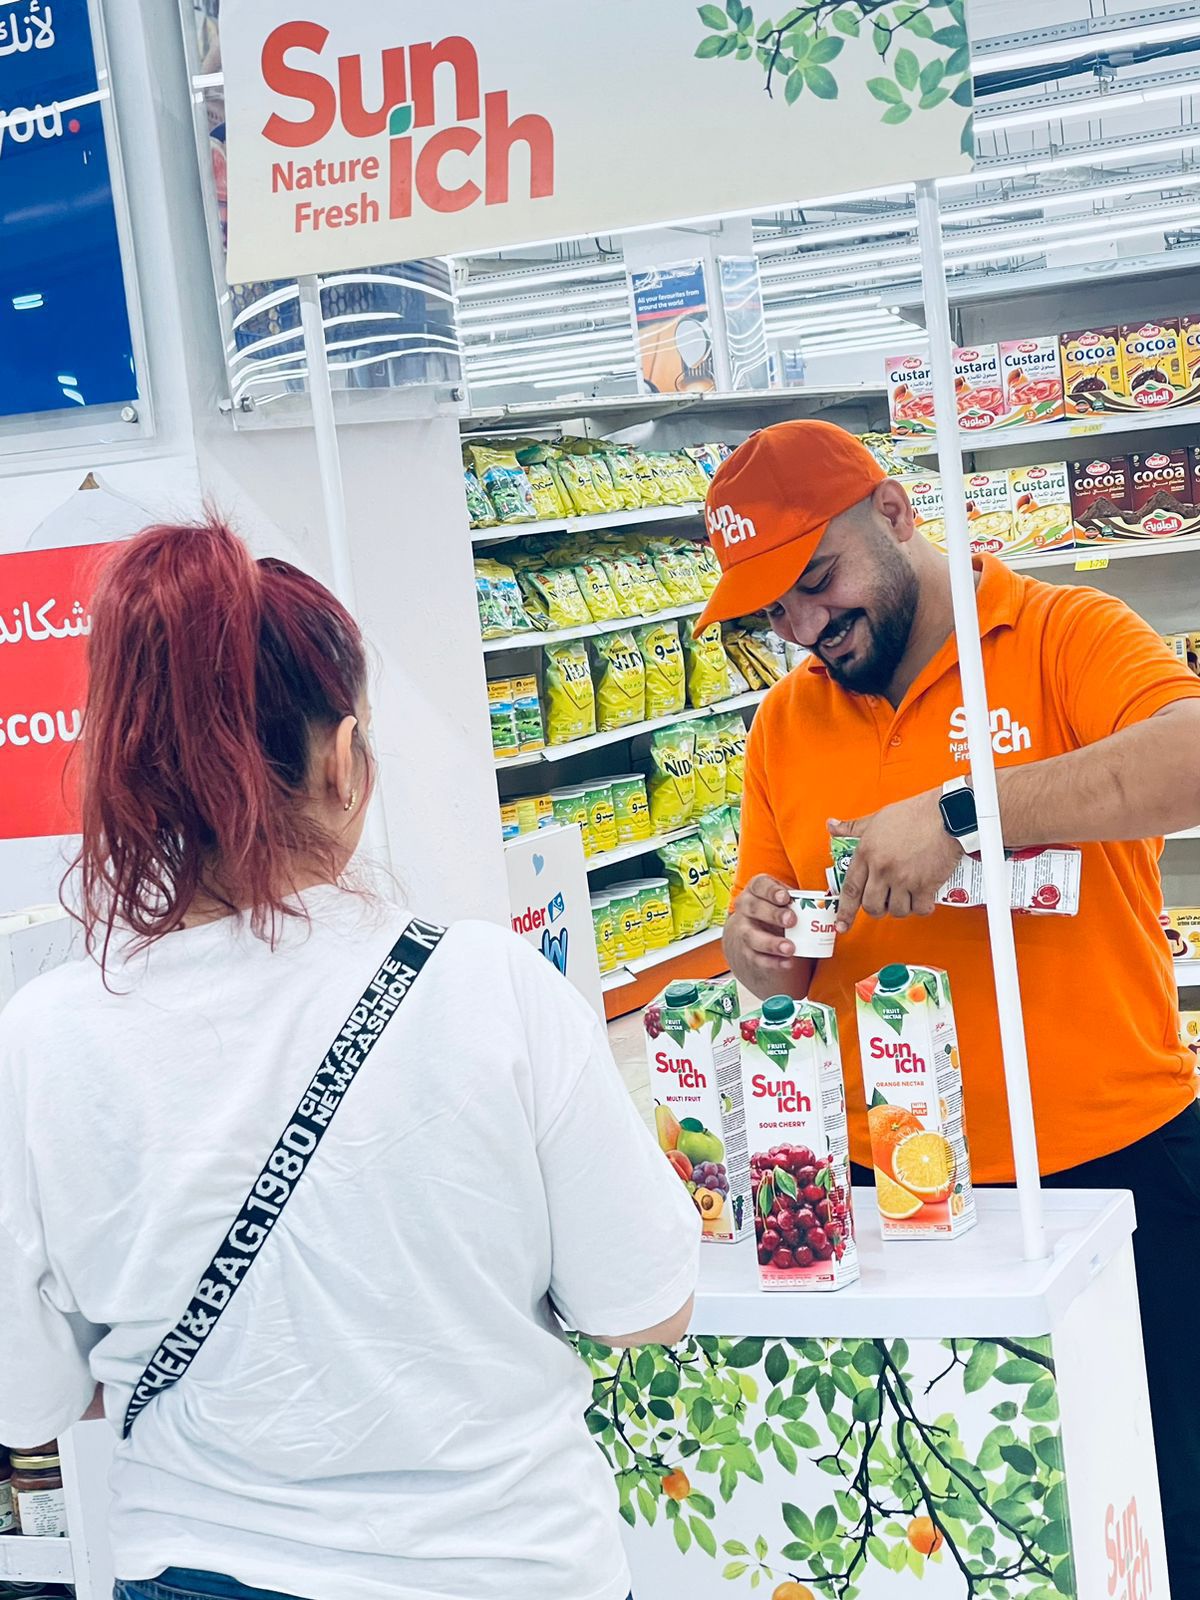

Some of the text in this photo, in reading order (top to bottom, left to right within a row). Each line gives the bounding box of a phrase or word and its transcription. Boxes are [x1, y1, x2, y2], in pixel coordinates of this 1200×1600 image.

[261, 20, 480, 148] Sun
[389, 90, 555, 220] ich
[271, 155, 380, 193] Nature
[294, 193, 380, 233] Fresh
[658, 291, 686, 299] favourites
[638, 303, 658, 312] around
[667, 299, 684, 307] world
[1066, 345, 1116, 362] cocoa
[1126, 337, 1177, 354] cocoa
[954, 359, 996, 374] ustard
[1004, 349, 1055, 367] Custard
[890, 369, 931, 383] Custar
[1074, 474, 1126, 491] cocoa
[1133, 466, 1185, 483] cocoa
[964, 485, 1008, 500] ustard
[1013, 476, 1066, 493] Custard
[911, 493, 944, 507] ustar
[948, 706, 1011, 740] Sn
[992, 721, 1032, 754] ch
[949, 743, 969, 753] Nat
[664, 759, 692, 778] NID
[510, 907, 546, 935] nder
[811, 920, 837, 933] Sun
[869, 1037, 912, 1059] Sun
[655, 1052, 693, 1073] Sun
[895, 1053, 926, 1073] ich
[678, 1069, 707, 1088] ich
[751, 1074, 796, 1098] Sun
[777, 1091, 811, 1113] ich
[1105, 1495, 1139, 1597] Sun
